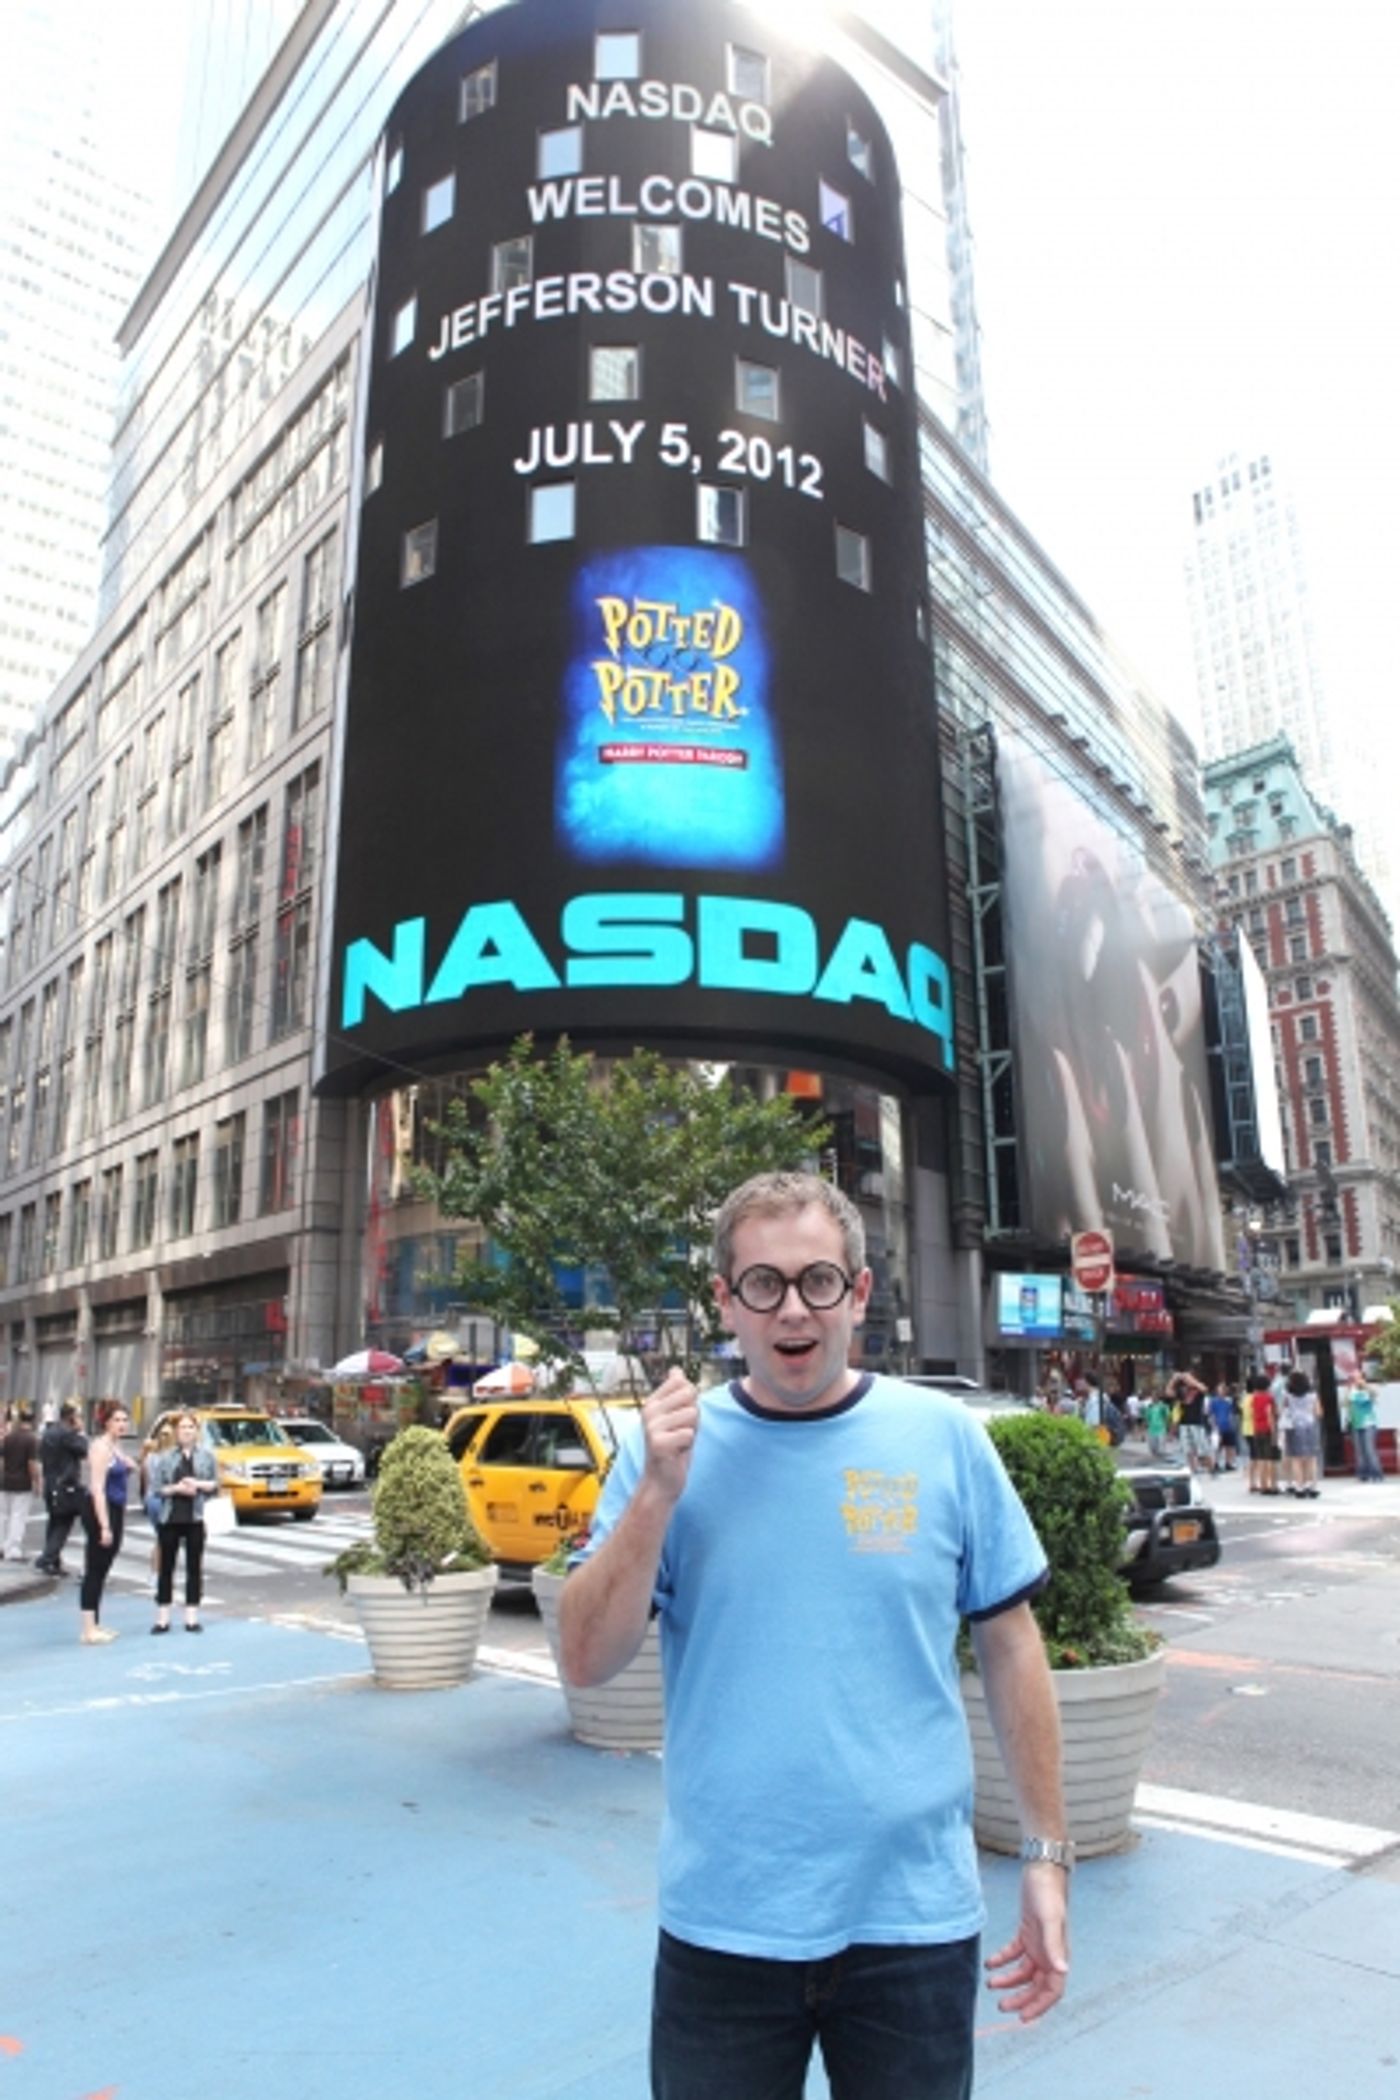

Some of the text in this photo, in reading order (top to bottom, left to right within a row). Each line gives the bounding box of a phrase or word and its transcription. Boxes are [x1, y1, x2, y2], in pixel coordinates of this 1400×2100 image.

[566, 80, 774, 147] NASDAQ
[527, 175, 810, 253] WELCOMES
[428, 271, 888, 402] JEFFERSON TURNER
[513, 421, 824, 499] JULY 5, 2012
[594, 596, 743, 659] POTTED
[591, 660, 743, 727] POTTER
[342, 893, 955, 1072] NASDAQ
